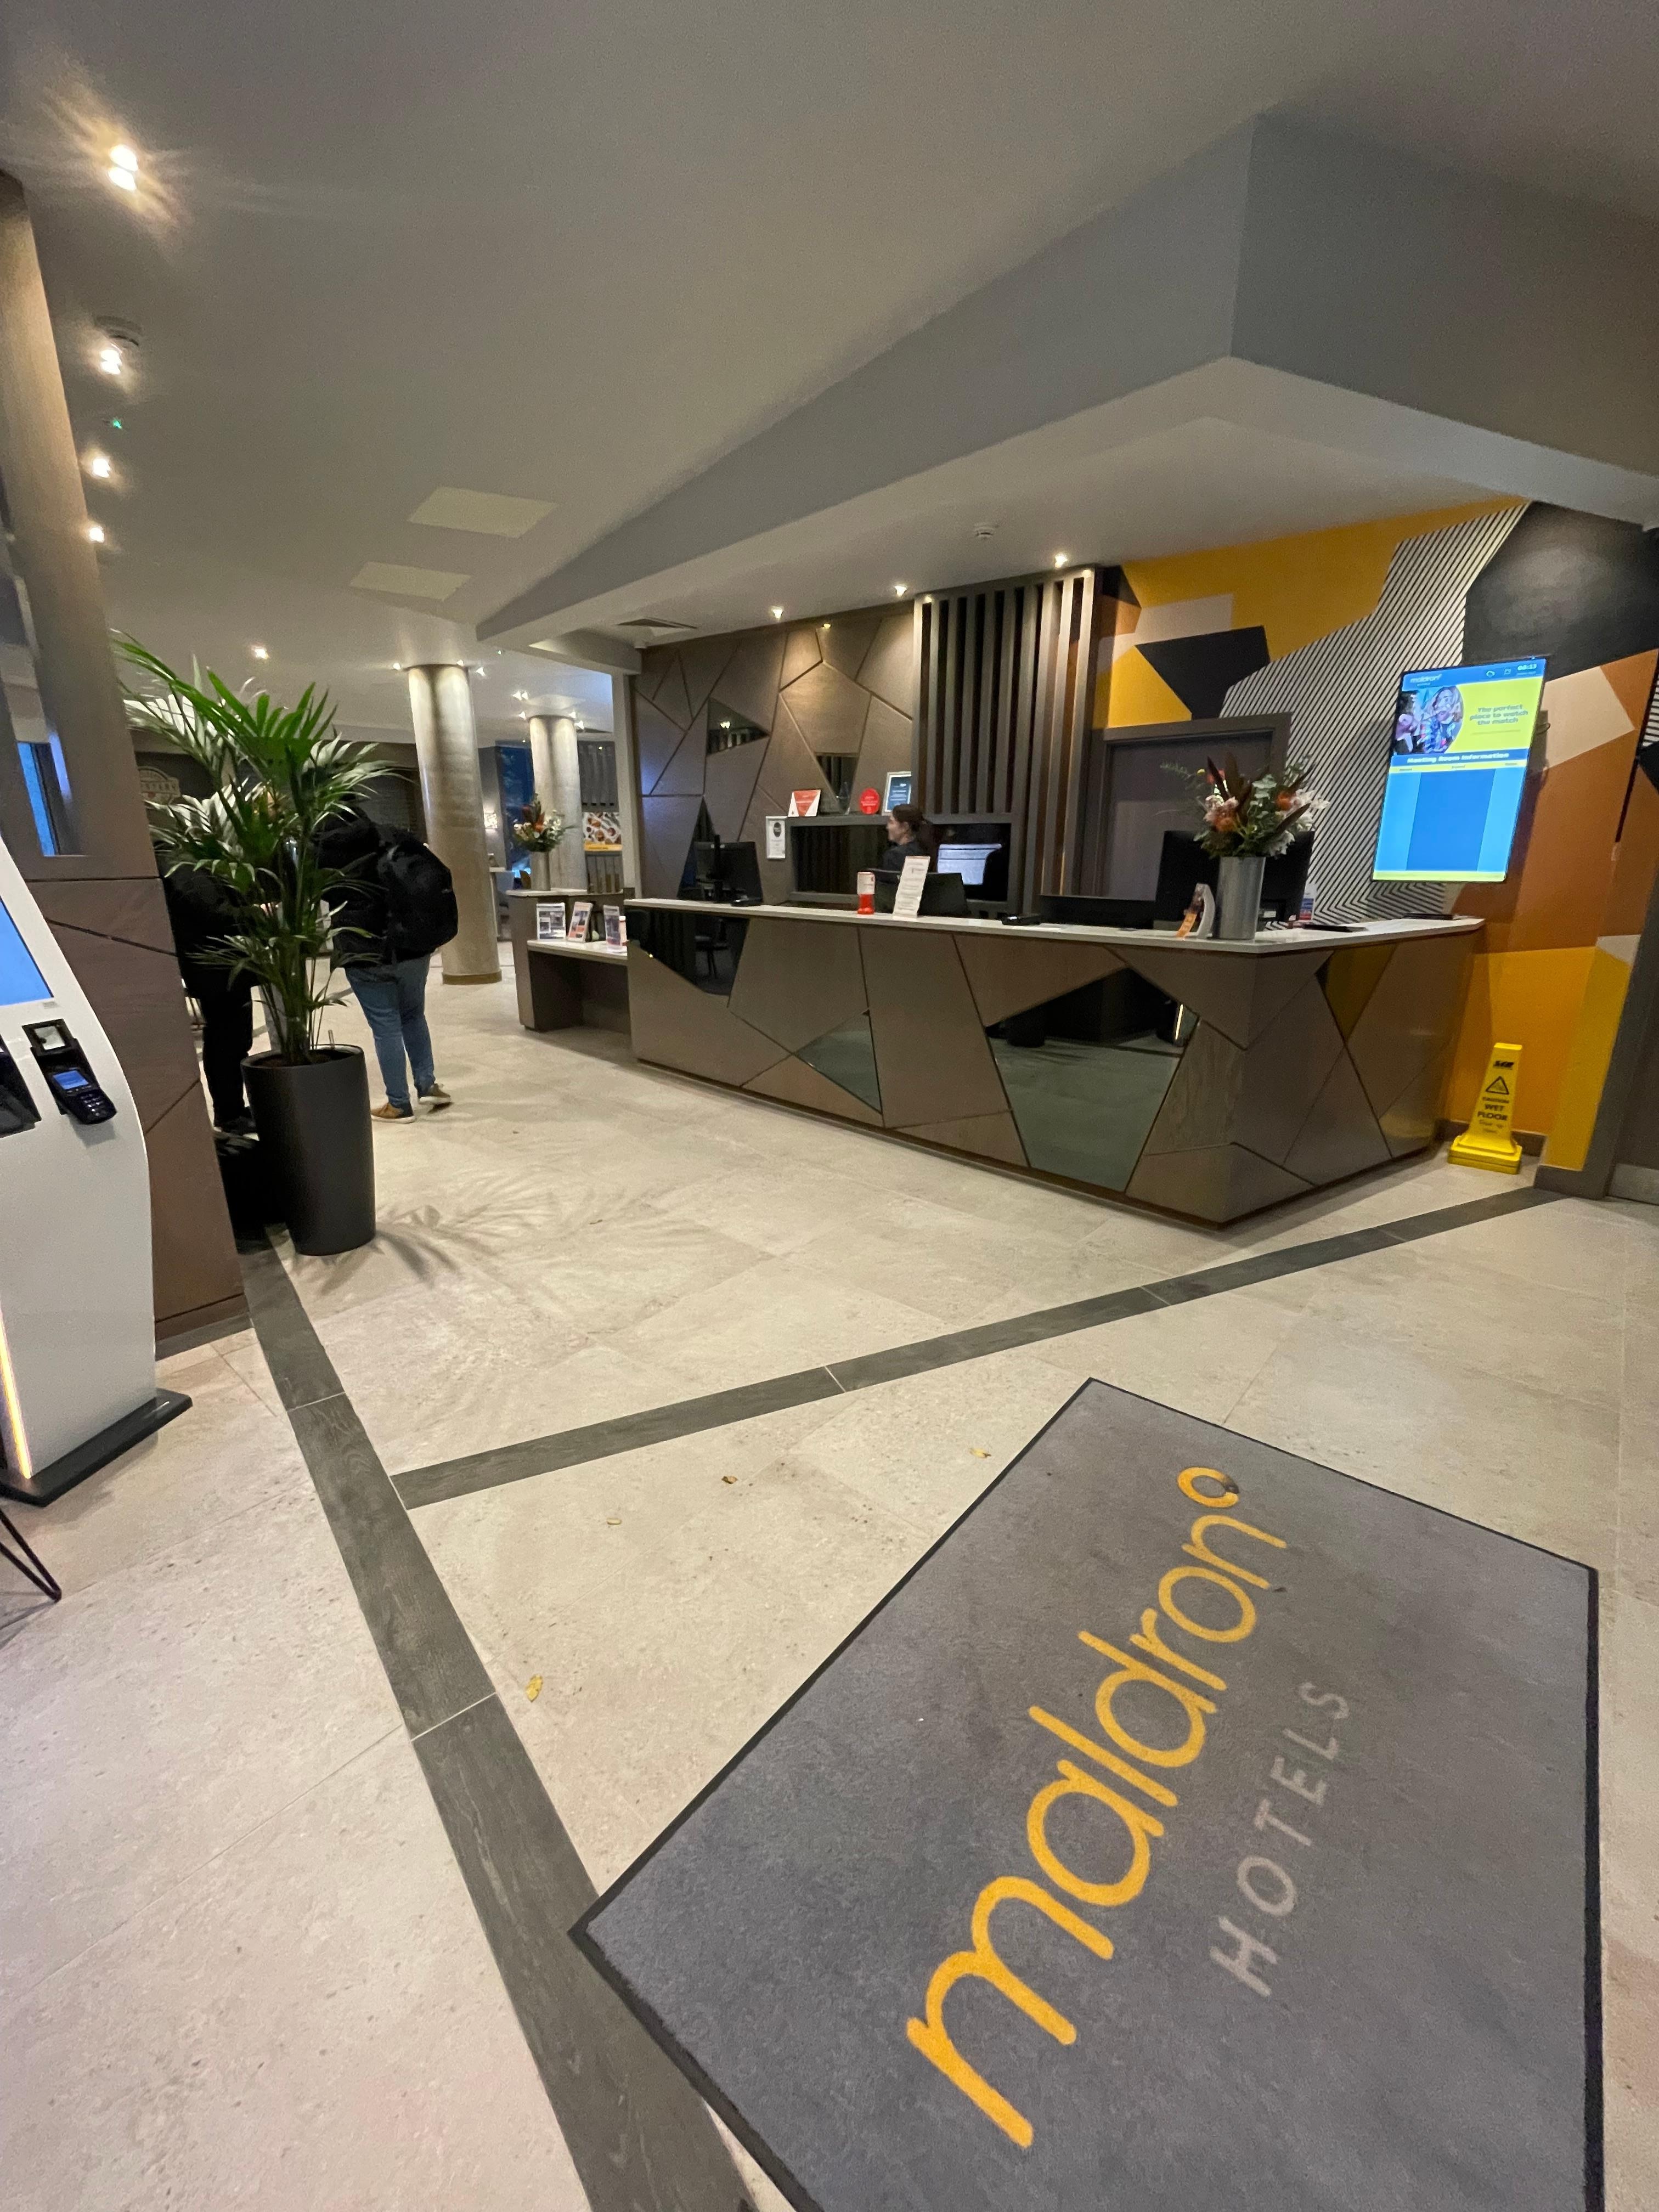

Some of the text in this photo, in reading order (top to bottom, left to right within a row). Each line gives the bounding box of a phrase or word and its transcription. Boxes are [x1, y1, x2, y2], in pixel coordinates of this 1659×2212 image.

[1477, 1111, 1508, 1120] FLOOR
[907, 1513, 1288, 2147] maldron
[1209, 1681, 1350, 1997] HOTELS
